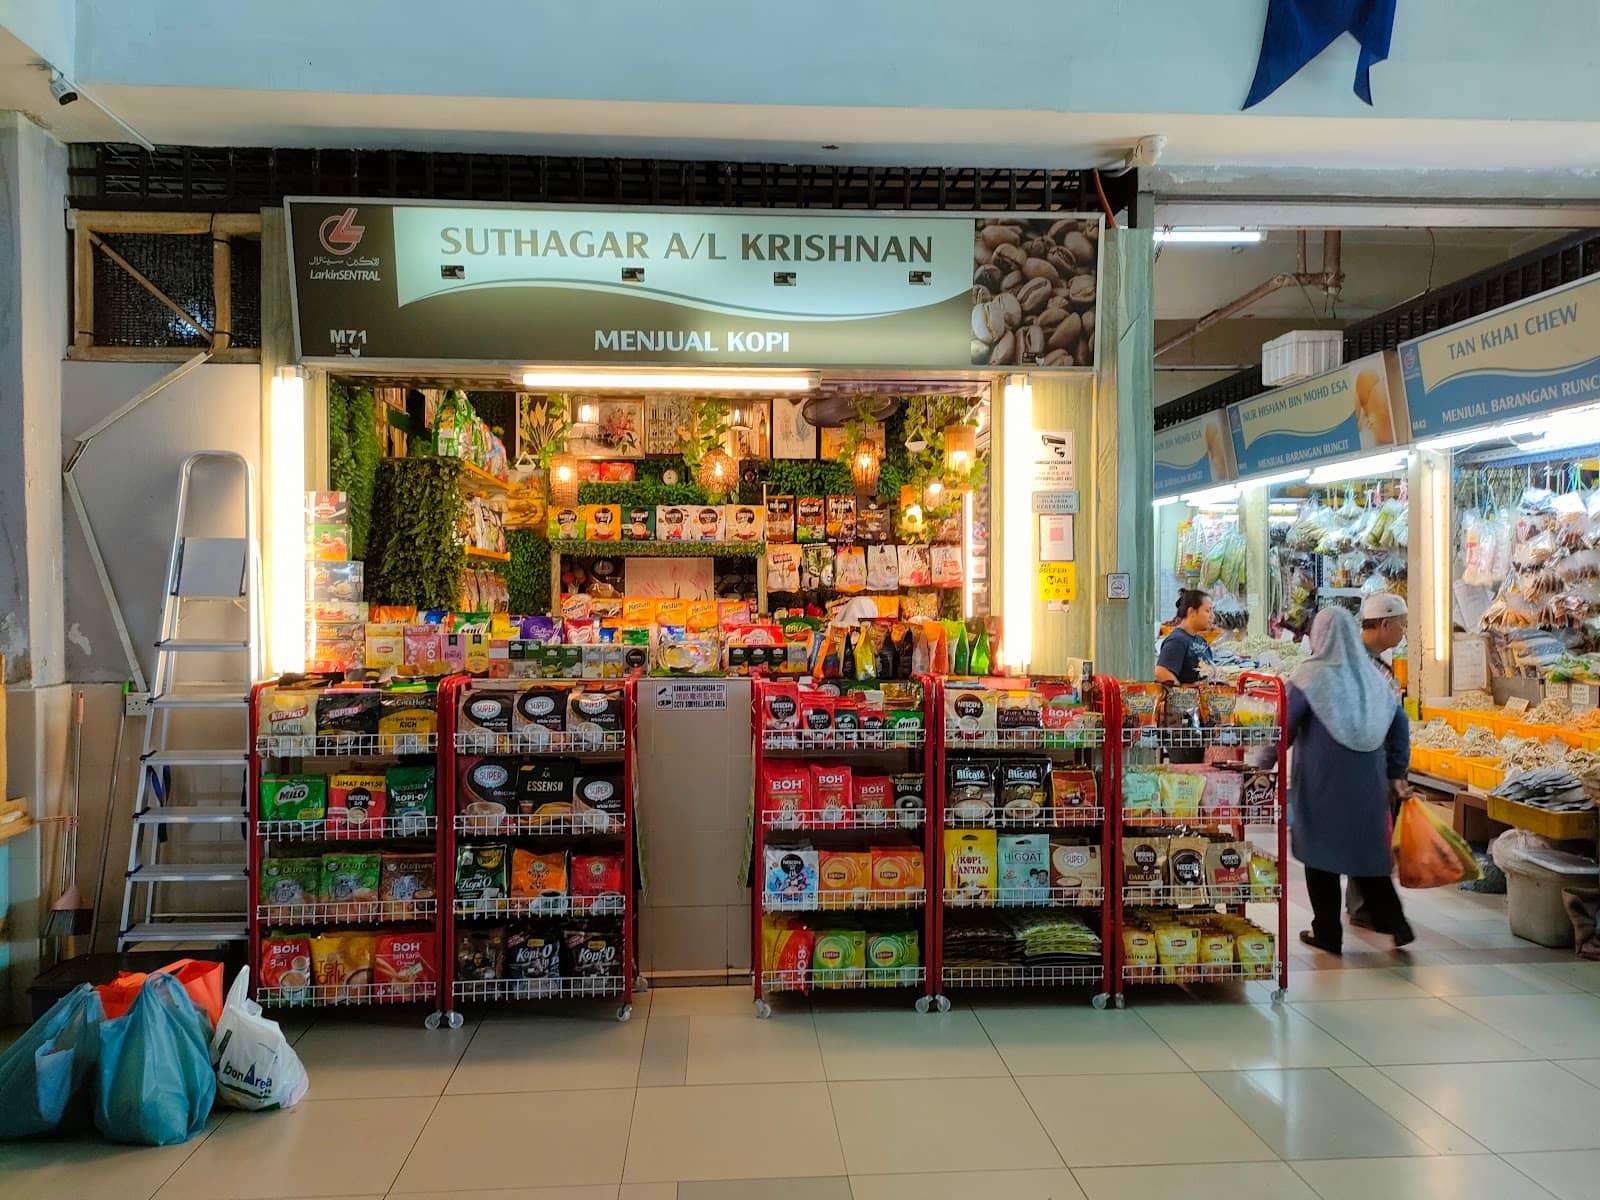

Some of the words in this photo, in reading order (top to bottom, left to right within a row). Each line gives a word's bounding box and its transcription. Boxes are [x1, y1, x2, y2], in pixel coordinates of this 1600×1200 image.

[440, 227, 649, 259] SUTHAGAR
[663, 232, 726, 261] A/L
[741, 233, 933, 263] KRISHNAN
[310, 268, 381, 281] LarkinSENTRAL
[330, 329, 367, 344] M71
[1447, 336, 1476, 360] TAN
[1479, 322, 1520, 351] KHAI
[1524, 303, 1578, 336] CHEW
[594, 329, 719, 352] MENJUAL
[727, 331, 790, 353] KOPI
[1288, 395, 1302, 409] BIN
[1303, 385, 1329, 403] MOHD
[1331, 379, 1348, 394] ESA
[1442, 401, 1489, 425] MENJUAL
[1490, 384, 1558, 413] BARANGAN
[1561, 374, 1600, 397] RUNC
[1048, 709, 1073, 717] BOH
[480, 771, 502, 780] SUPER
[818, 774, 843, 784] BOH
[589, 786, 608, 794] SUPER
[772, 780, 802, 790] BOH
[861, 785, 884, 794] BOH
[278, 790, 306, 801] MILO
[1004, 852, 1042, 862] HIGOAT
[272, 944, 300, 955] BOH
[392, 941, 421, 952] BOH
[223, 1061, 273, 1090] bonArea
